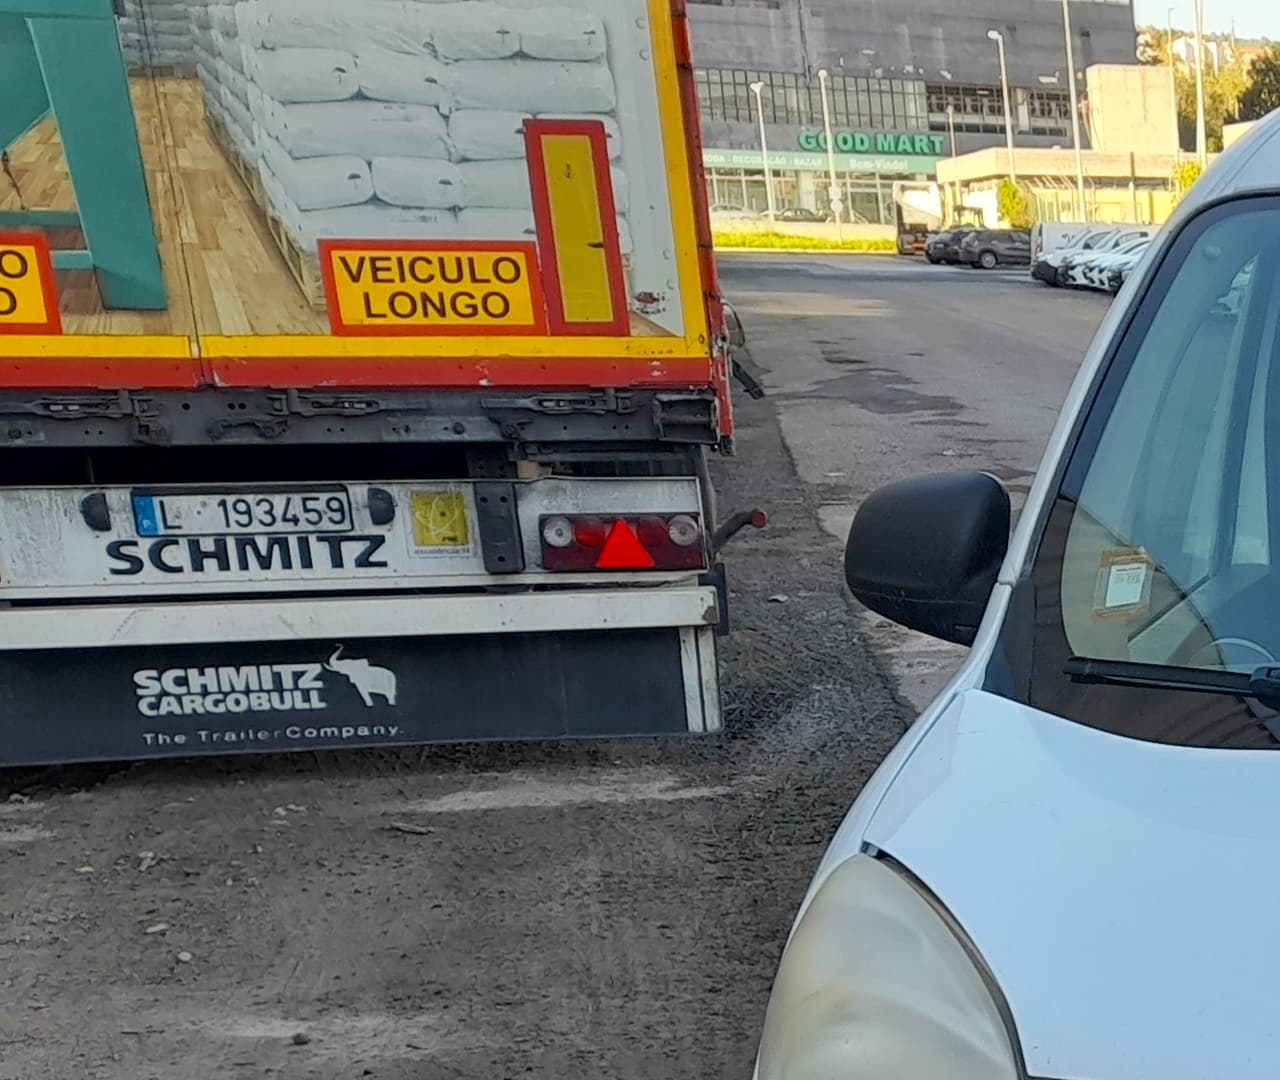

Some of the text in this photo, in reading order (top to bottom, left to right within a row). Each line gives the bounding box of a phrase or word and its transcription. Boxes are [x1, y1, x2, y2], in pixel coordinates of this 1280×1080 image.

[875, 132, 945, 154] MART
[339, 255, 521, 284] VEICULO
[363, 290, 510, 319] LONGO
[159, 499, 183, 530] L
[217, 496, 346, 529] 193459
[106, 534, 389, 575] SCHMITZ
[133, 662, 324, 696] SCHMITZ
[137, 690, 328, 717] CARGOBULL
[142, 732, 187, 745] The
